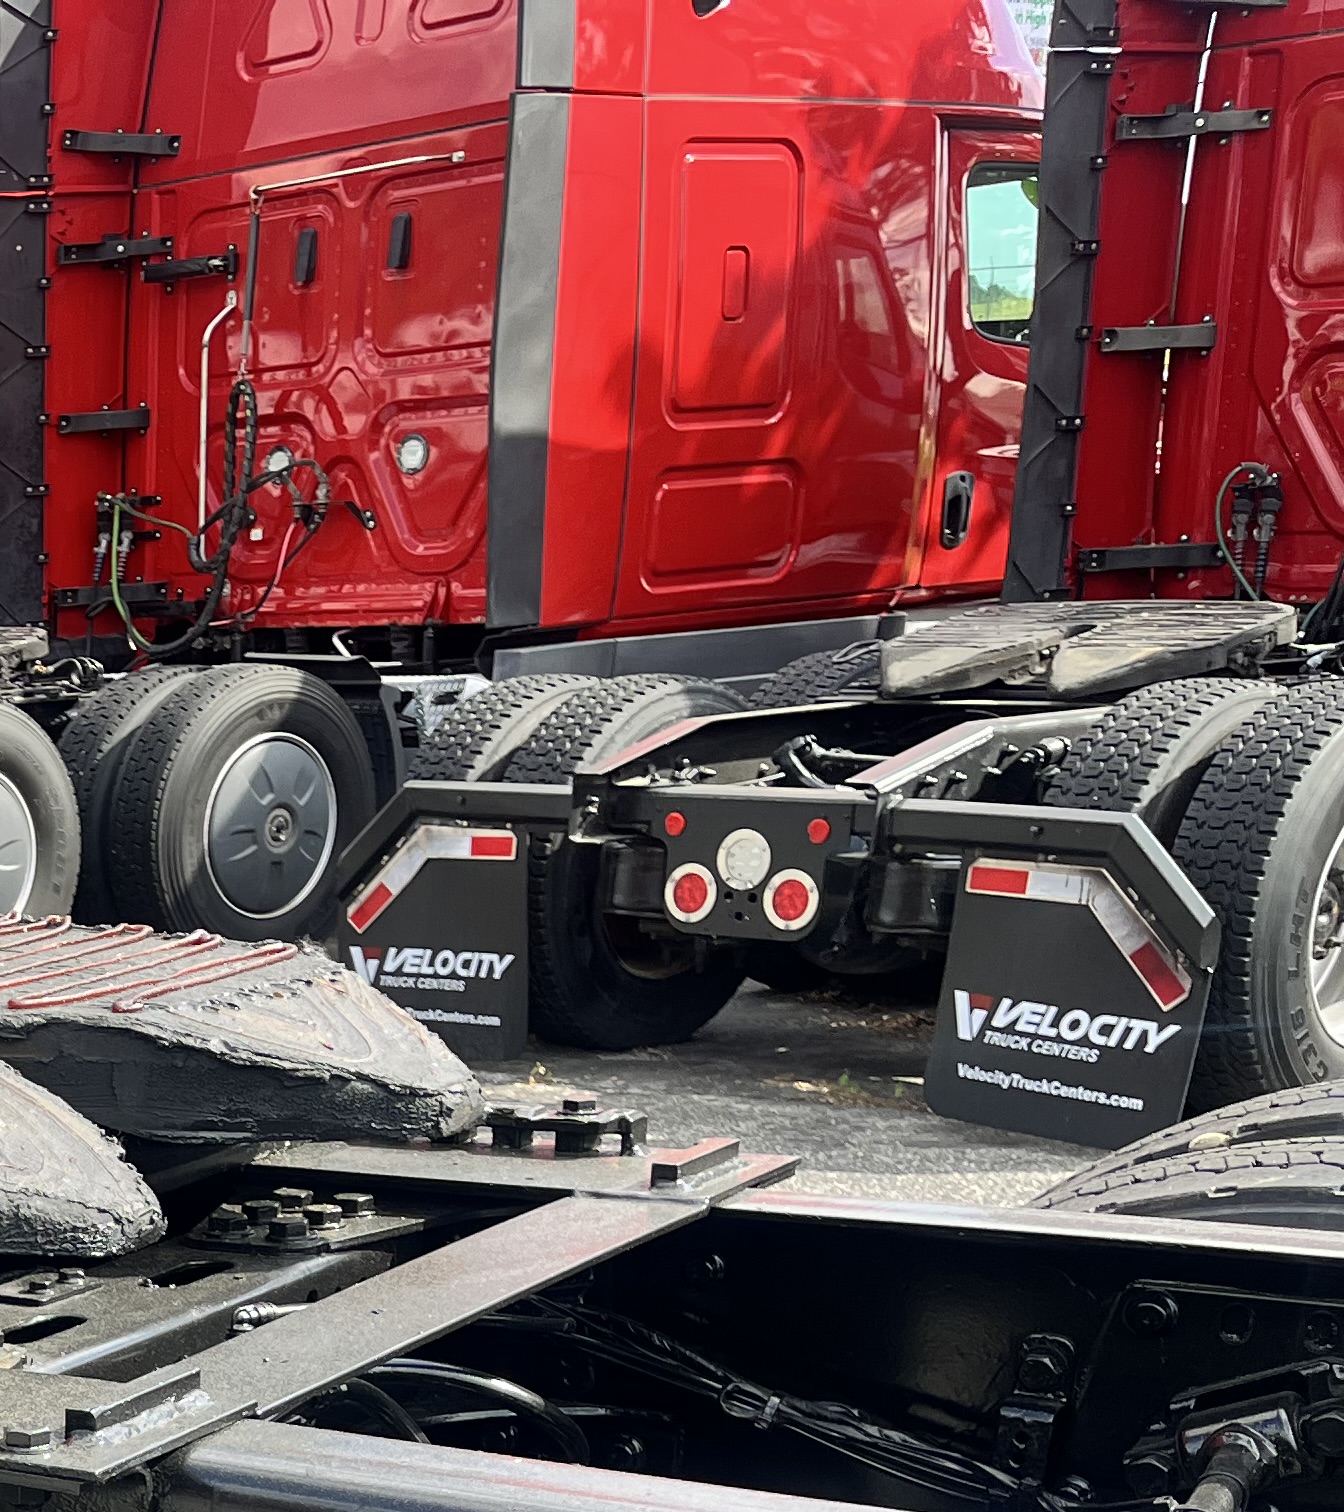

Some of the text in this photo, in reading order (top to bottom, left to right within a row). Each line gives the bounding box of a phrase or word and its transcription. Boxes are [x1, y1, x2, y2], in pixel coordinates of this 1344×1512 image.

[383, 946, 515, 980] VELOCITY
[379, 974, 466, 992] TRUCK CENTERS
[990, 997, 1182, 1053] VELOCITY
[982, 1029, 1100, 1064] TRUCK CENTERS
[957, 1062, 1144, 1111] VelocityTruckCenters.com
